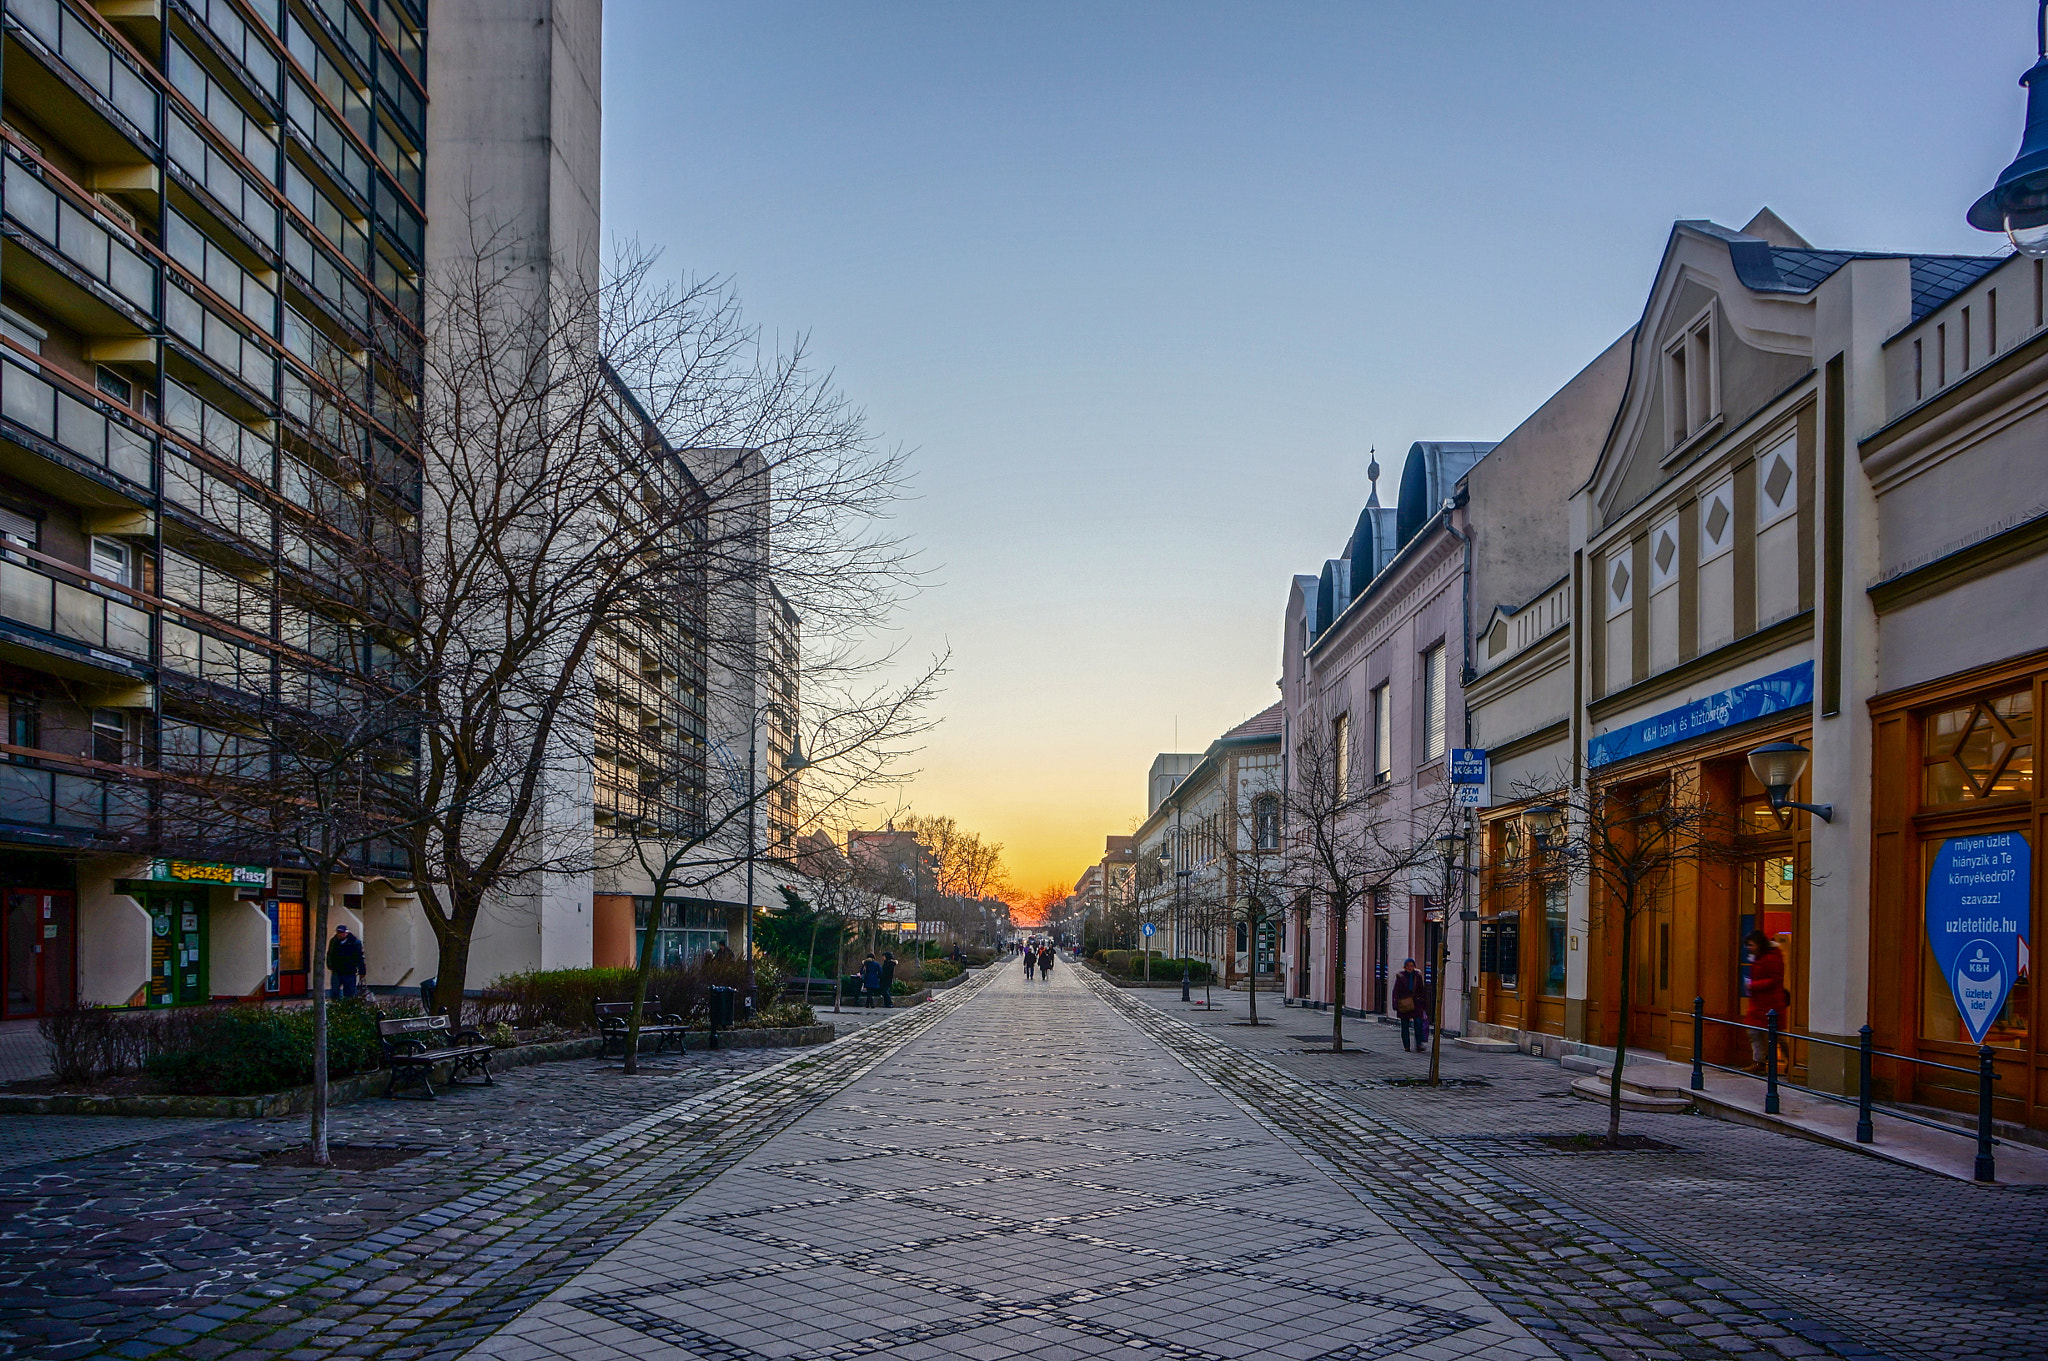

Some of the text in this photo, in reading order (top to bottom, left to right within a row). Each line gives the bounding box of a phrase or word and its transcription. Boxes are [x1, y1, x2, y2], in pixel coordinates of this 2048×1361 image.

[1643, 702, 1729, 742] K&H bank és biztosítás
[1453, 765, 1483, 775] K&H
[1461, 787, 1479, 795] ATM
[1460, 795, 1479, 803] 0-24
[1954, 835, 2011, 852] milyen üzlet
[1952, 852, 2012, 869] hiányzik a Te
[1949, 869, 2016, 886] környékedről?
[1961, 892, 2001, 905] szavazz!
[1946, 917, 2017, 933] uzletetide.hu
[1969, 963, 1990, 973] K&H
[1965, 988, 1993, 1000] üzletet
[1970, 1000, 1986, 1011] ide!
